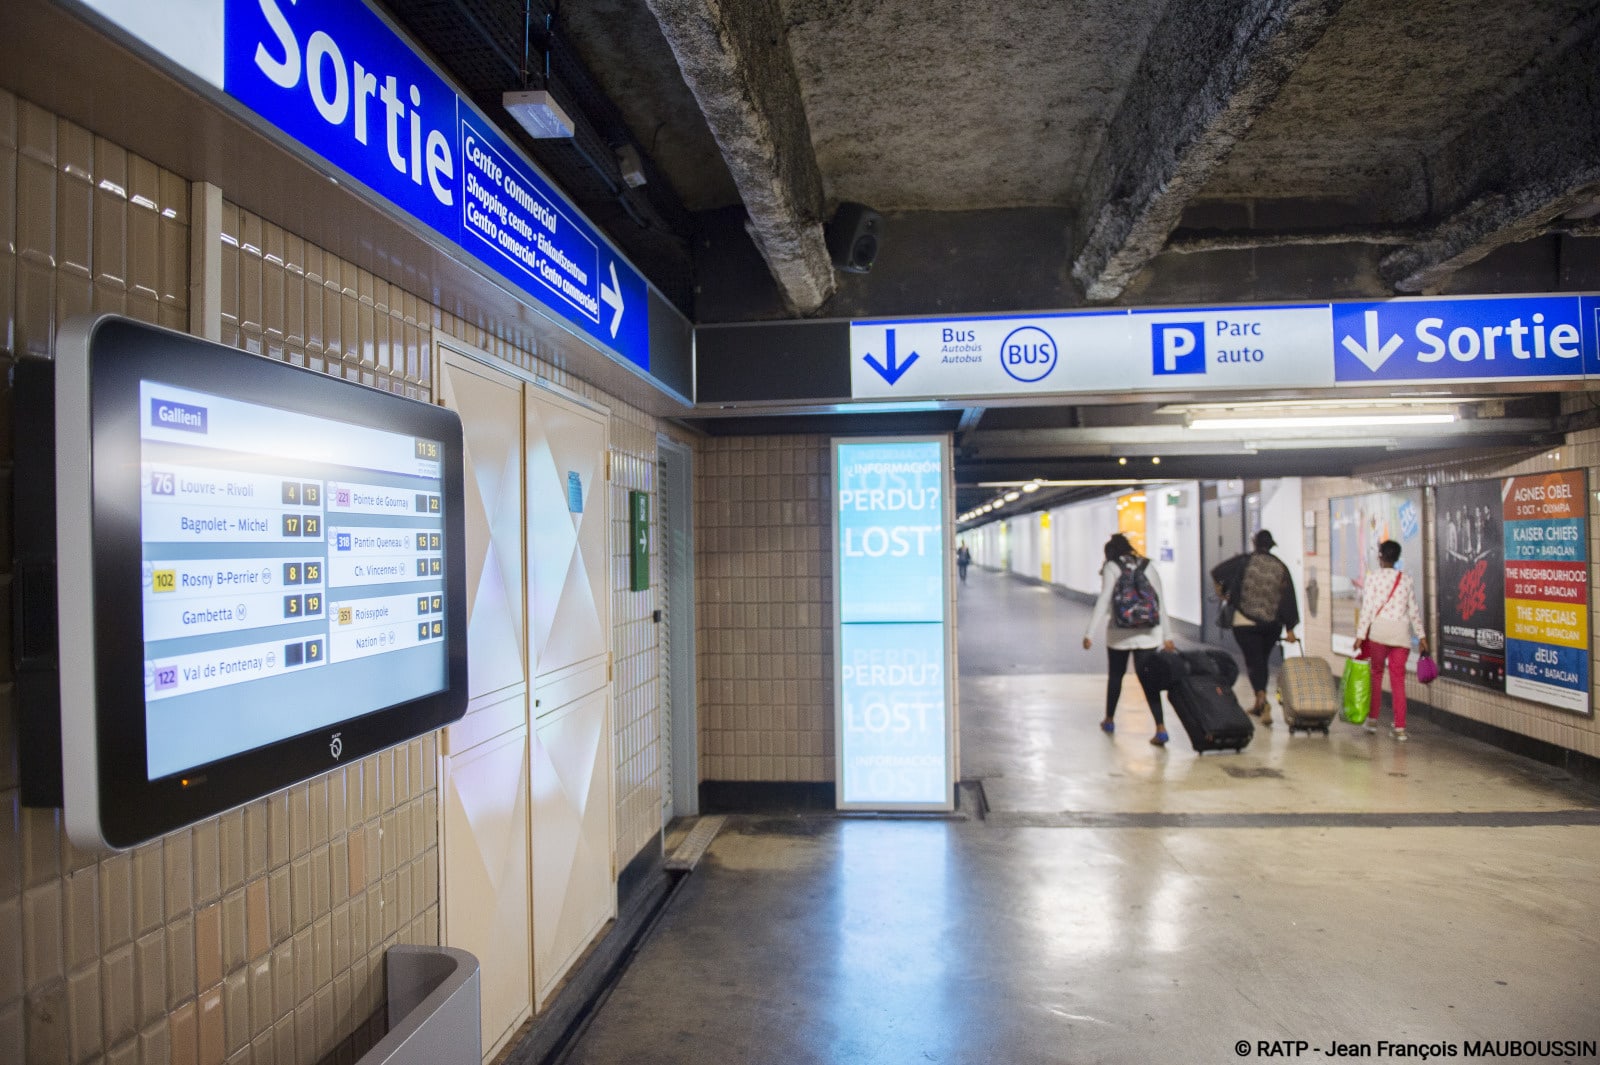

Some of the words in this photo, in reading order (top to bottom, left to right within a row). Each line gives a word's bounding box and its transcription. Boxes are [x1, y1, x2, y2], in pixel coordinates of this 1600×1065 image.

[254, 0, 453, 206] Sortie
[466, 136, 502, 186] Centre
[504, 175, 556, 234] commercial
[467, 172, 508, 225] Shopping
[508, 212, 532, 241] centre
[538, 232, 587, 286] Einkaufszentrum
[467, 202, 497, 239] Centro
[498, 229, 535, 268] comercial
[541, 259, 562, 288] Centro
[562, 279, 597, 315] commerciale
[942, 328, 975, 342] Bus
[1216, 320, 1261, 336] Parc
[1415, 313, 1580, 363] Sortie
[941, 354, 982, 364] Autobus
[1009, 344, 1050, 364] BUS
[1163, 327, 1196, 371] P
[1217, 347, 1264, 363] auto
[158, 406, 202, 427] Gallieni
[154, 473, 172, 494] 76
[180, 480, 215, 494] Louvre
[227, 483, 254, 497] Rivoli
[288, 487, 295, 499] 4
[306, 488, 317, 501] 13
[1514, 486, 1545, 502] AGNES
[1547, 484, 1572, 500] OBEL
[338, 492, 349, 503] 221
[376, 494, 384, 506] de
[431, 499, 438, 509] 22
[839, 487, 939, 511] PERDU?
[1523, 504, 1535, 515] OCT
[181, 517, 227, 534] Bagnolet
[238, 518, 268, 532] Michel
[287, 518, 297, 532] 17
[307, 519, 317, 532] 21
[1513, 527, 1544, 542] KAISER
[1546, 526, 1578, 541] CHIEFS
[354, 537, 374, 548] Pantin
[419, 536, 426, 547] 15
[431, 536, 438, 546] 31
[845, 525, 942, 557] LOST
[1522, 545, 1535, 555] OCT
[1542, 545, 1575, 556] BATACLAN
[157, 574, 173, 587] 102
[182, 573, 213, 587] Rosny
[217, 571, 258, 584] B-Perrier
[290, 566, 296, 580] 8
[308, 566, 318, 579] 26
[355, 565, 365, 577] Ch.
[367, 564, 397, 576] Vincennes
[421, 562, 425, 572] 1
[432, 561, 440, 571] 14
[1506, 567, 1518, 579] THE
[1520, 568, 1587, 582] NEIGHBOURHOOD
[1524, 585, 1537, 594] OCT
[1544, 585, 1577, 597] BATACLAN
[182, 608, 233, 625] Gambetta
[290, 600, 296, 613] 5
[309, 597, 318, 610] 19
[340, 611, 351, 622] 351
[420, 600, 427, 611] 11
[1516, 606, 1533, 621] THE
[1535, 608, 1577, 626] SPECIALS
[356, 637, 377, 649] Nation
[421, 626, 427, 636] 4
[158, 671, 175, 685] 122
[183, 666, 199, 681] Val
[204, 664, 216, 678] de
[220, 657, 263, 675] Fontenay
[311, 644, 317, 657] 9
[842, 663, 940, 686] PERDU?
[1545, 668, 1578, 684] BATACLAN
[847, 702, 944, 732] LOST
